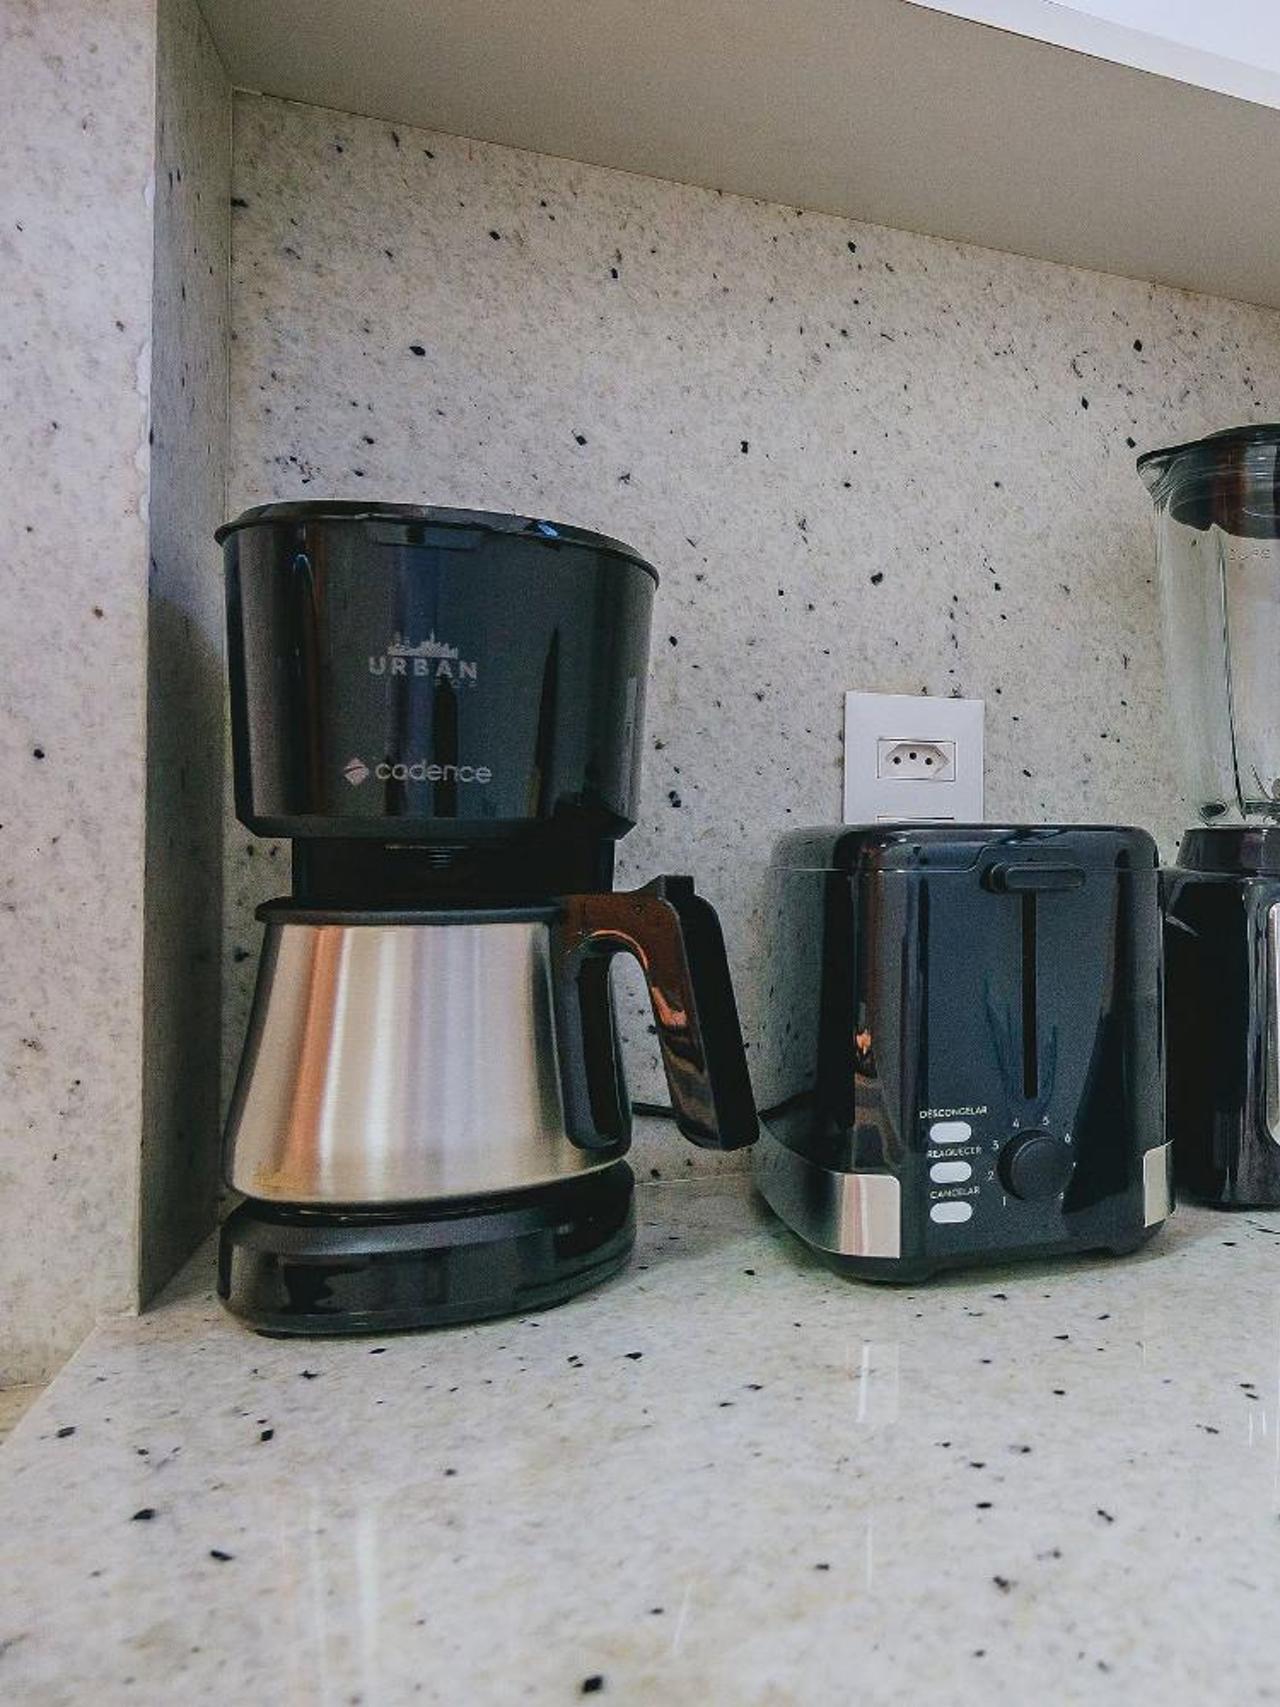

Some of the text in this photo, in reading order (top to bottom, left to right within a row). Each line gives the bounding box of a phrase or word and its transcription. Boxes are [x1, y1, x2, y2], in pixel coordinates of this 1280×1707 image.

[368, 657, 477, 678] URBAN
[375, 759, 492, 782] cadence
[919, 1105, 988, 1119] DESCONGELAR
